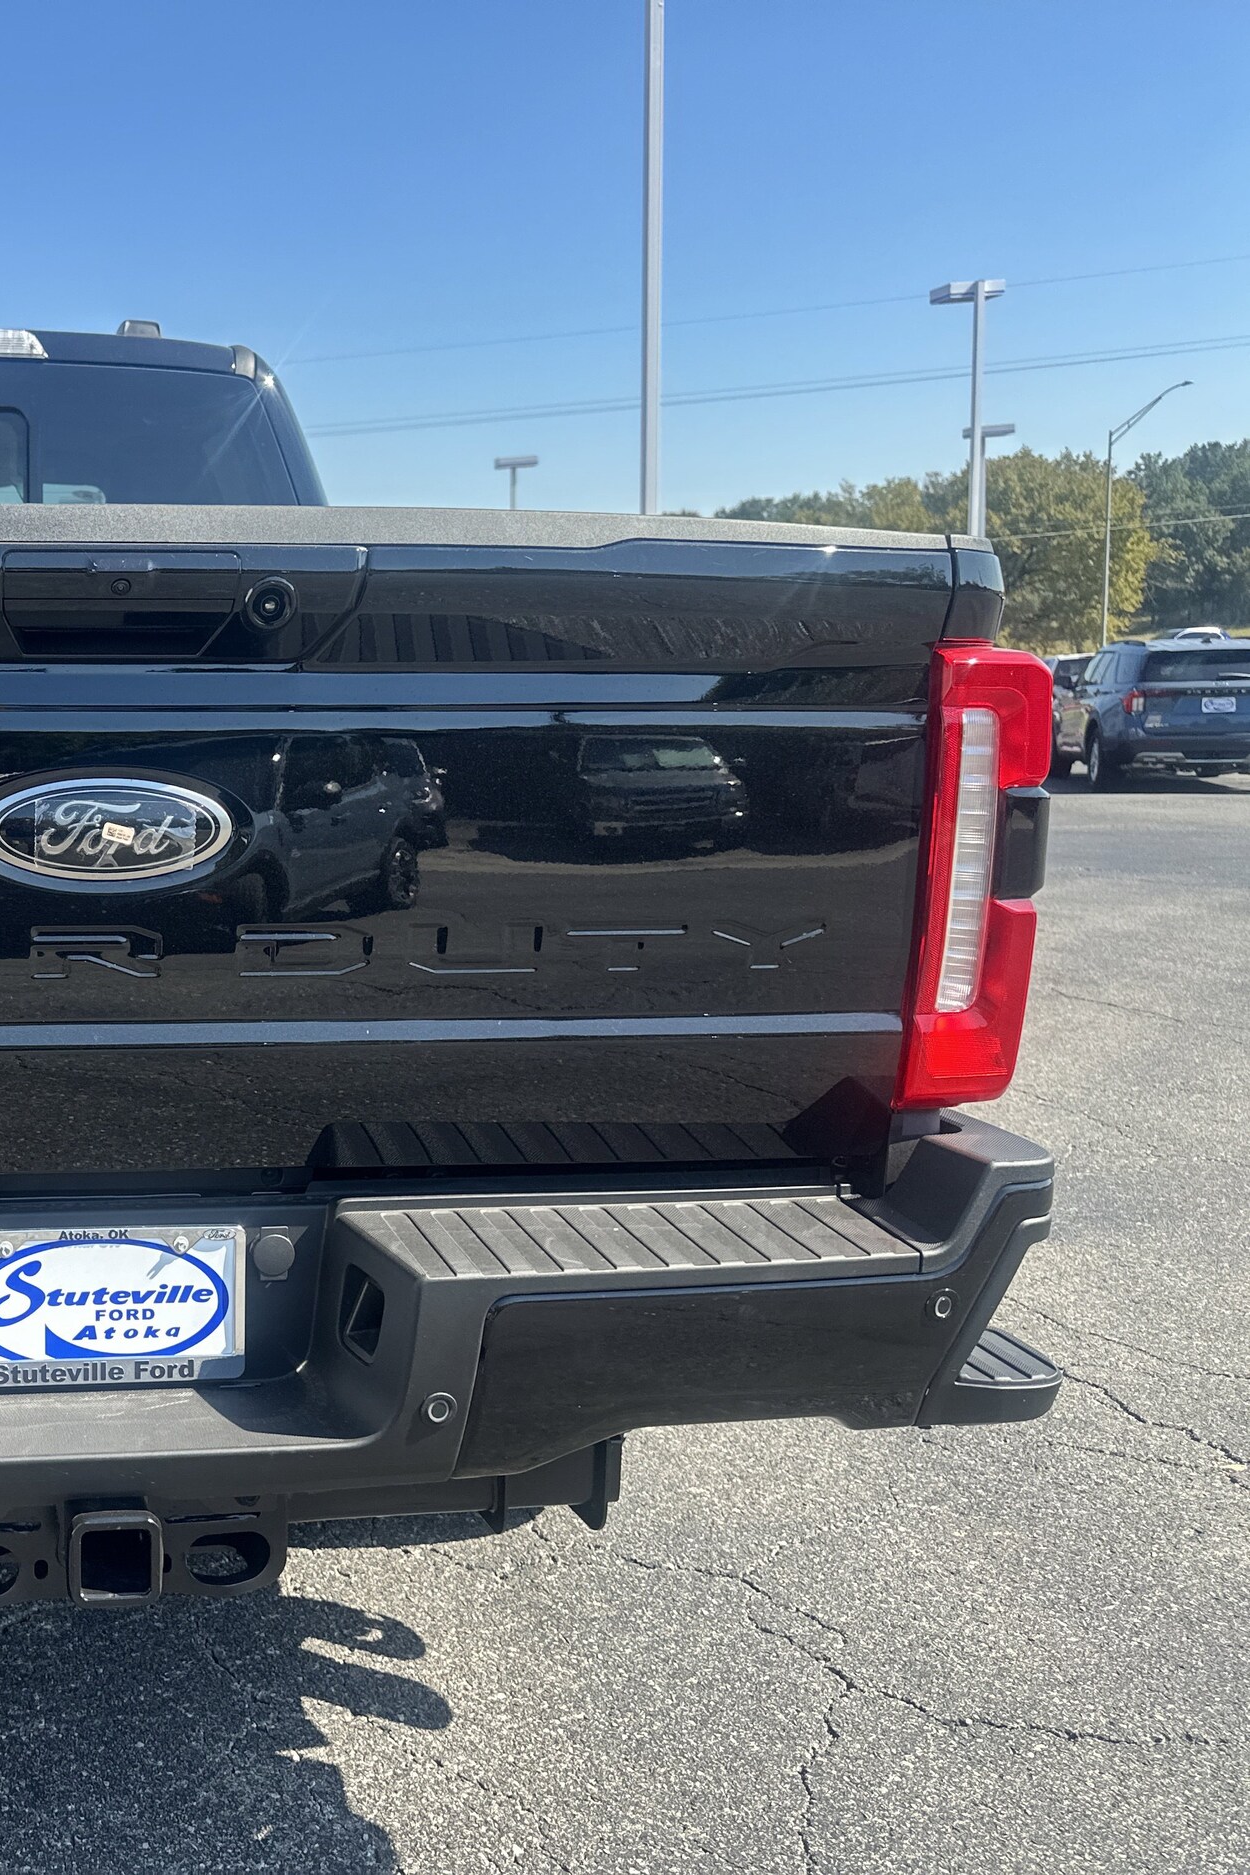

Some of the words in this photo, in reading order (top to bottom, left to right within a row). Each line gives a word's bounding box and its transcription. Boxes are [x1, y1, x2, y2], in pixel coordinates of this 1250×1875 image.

[237, 922, 827, 977] DUTY
[108, 1229, 129, 1240] OK
[208, 1229, 231, 1239] Ford
[95, 1308, 156, 1322] FORD
[72, 1325, 181, 1341] Atoka
[134, 1359, 195, 1381] Ford
